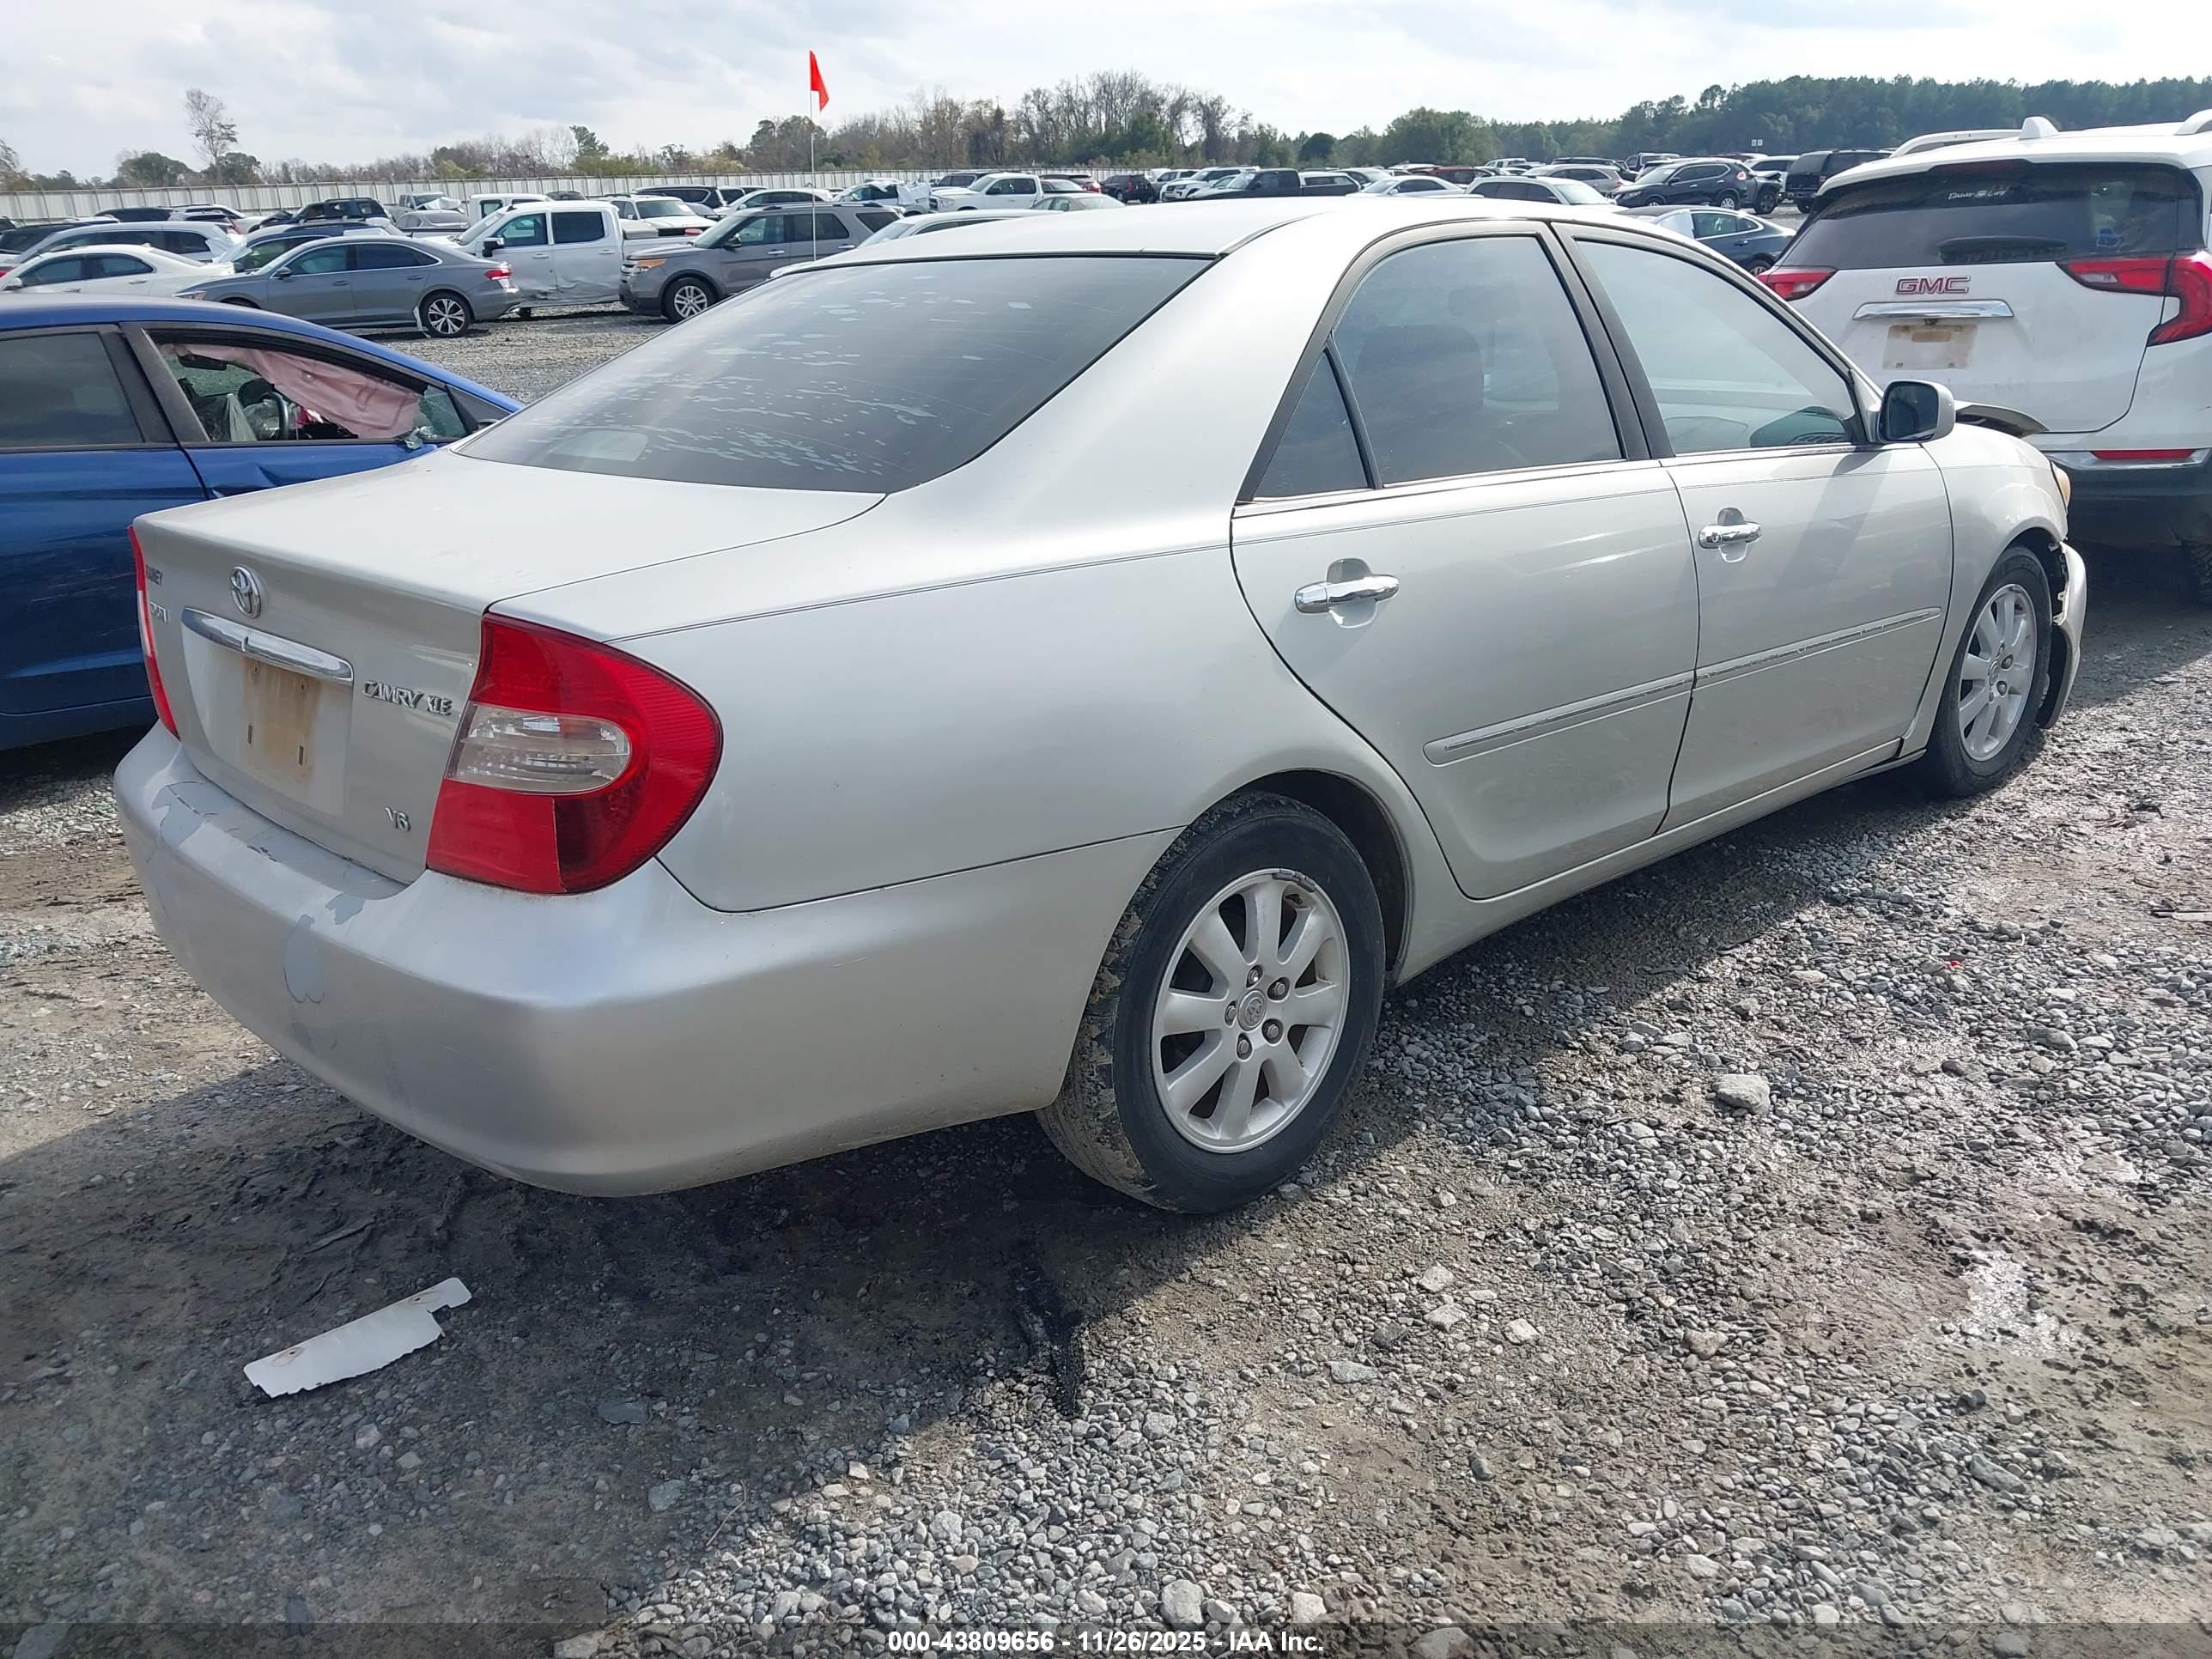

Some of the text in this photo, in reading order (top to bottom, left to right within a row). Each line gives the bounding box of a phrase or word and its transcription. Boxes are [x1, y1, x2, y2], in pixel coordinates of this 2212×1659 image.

[1895, 275, 1971, 295] GMC
[362, 679, 453, 715] CAMRY XLE
[385, 806, 411, 831] V6
